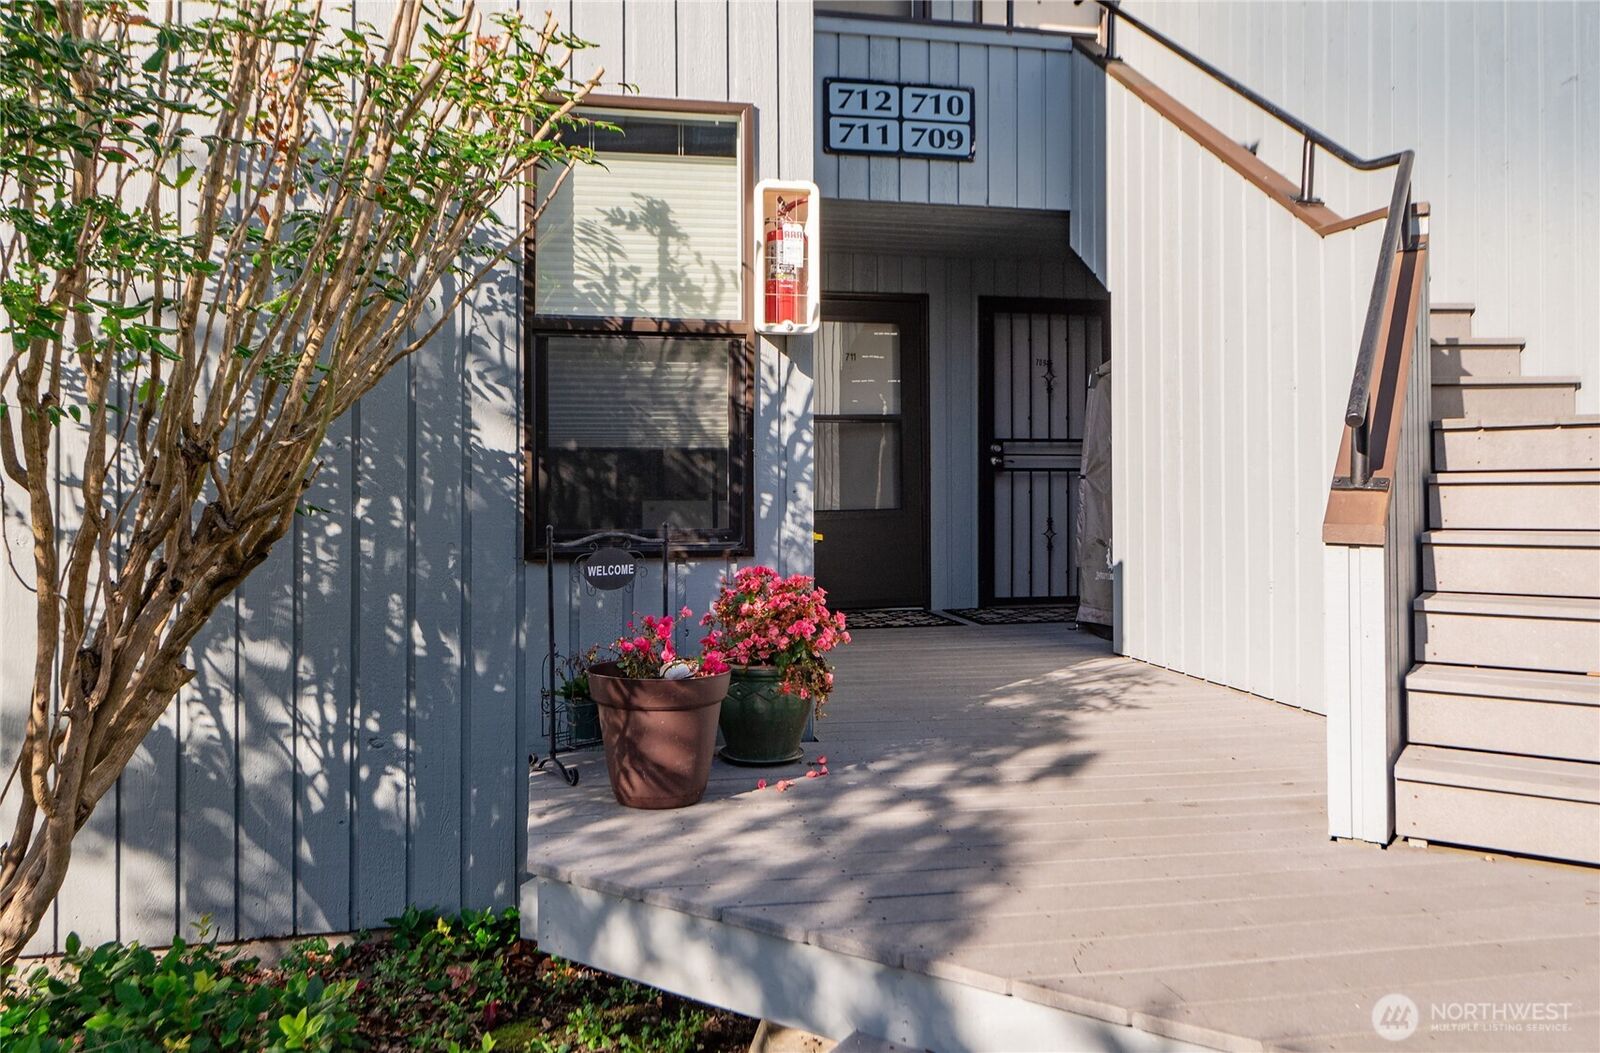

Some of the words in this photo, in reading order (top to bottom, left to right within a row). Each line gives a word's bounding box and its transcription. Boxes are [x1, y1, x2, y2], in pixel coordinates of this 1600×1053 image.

[837, 88, 892, 111] 712
[911, 93, 964, 116] 710
[838, 122, 888, 145] 711
[911, 127, 964, 149] 709
[845, 352, 857, 361] 711
[587, 564, 634, 576] WELCOME
